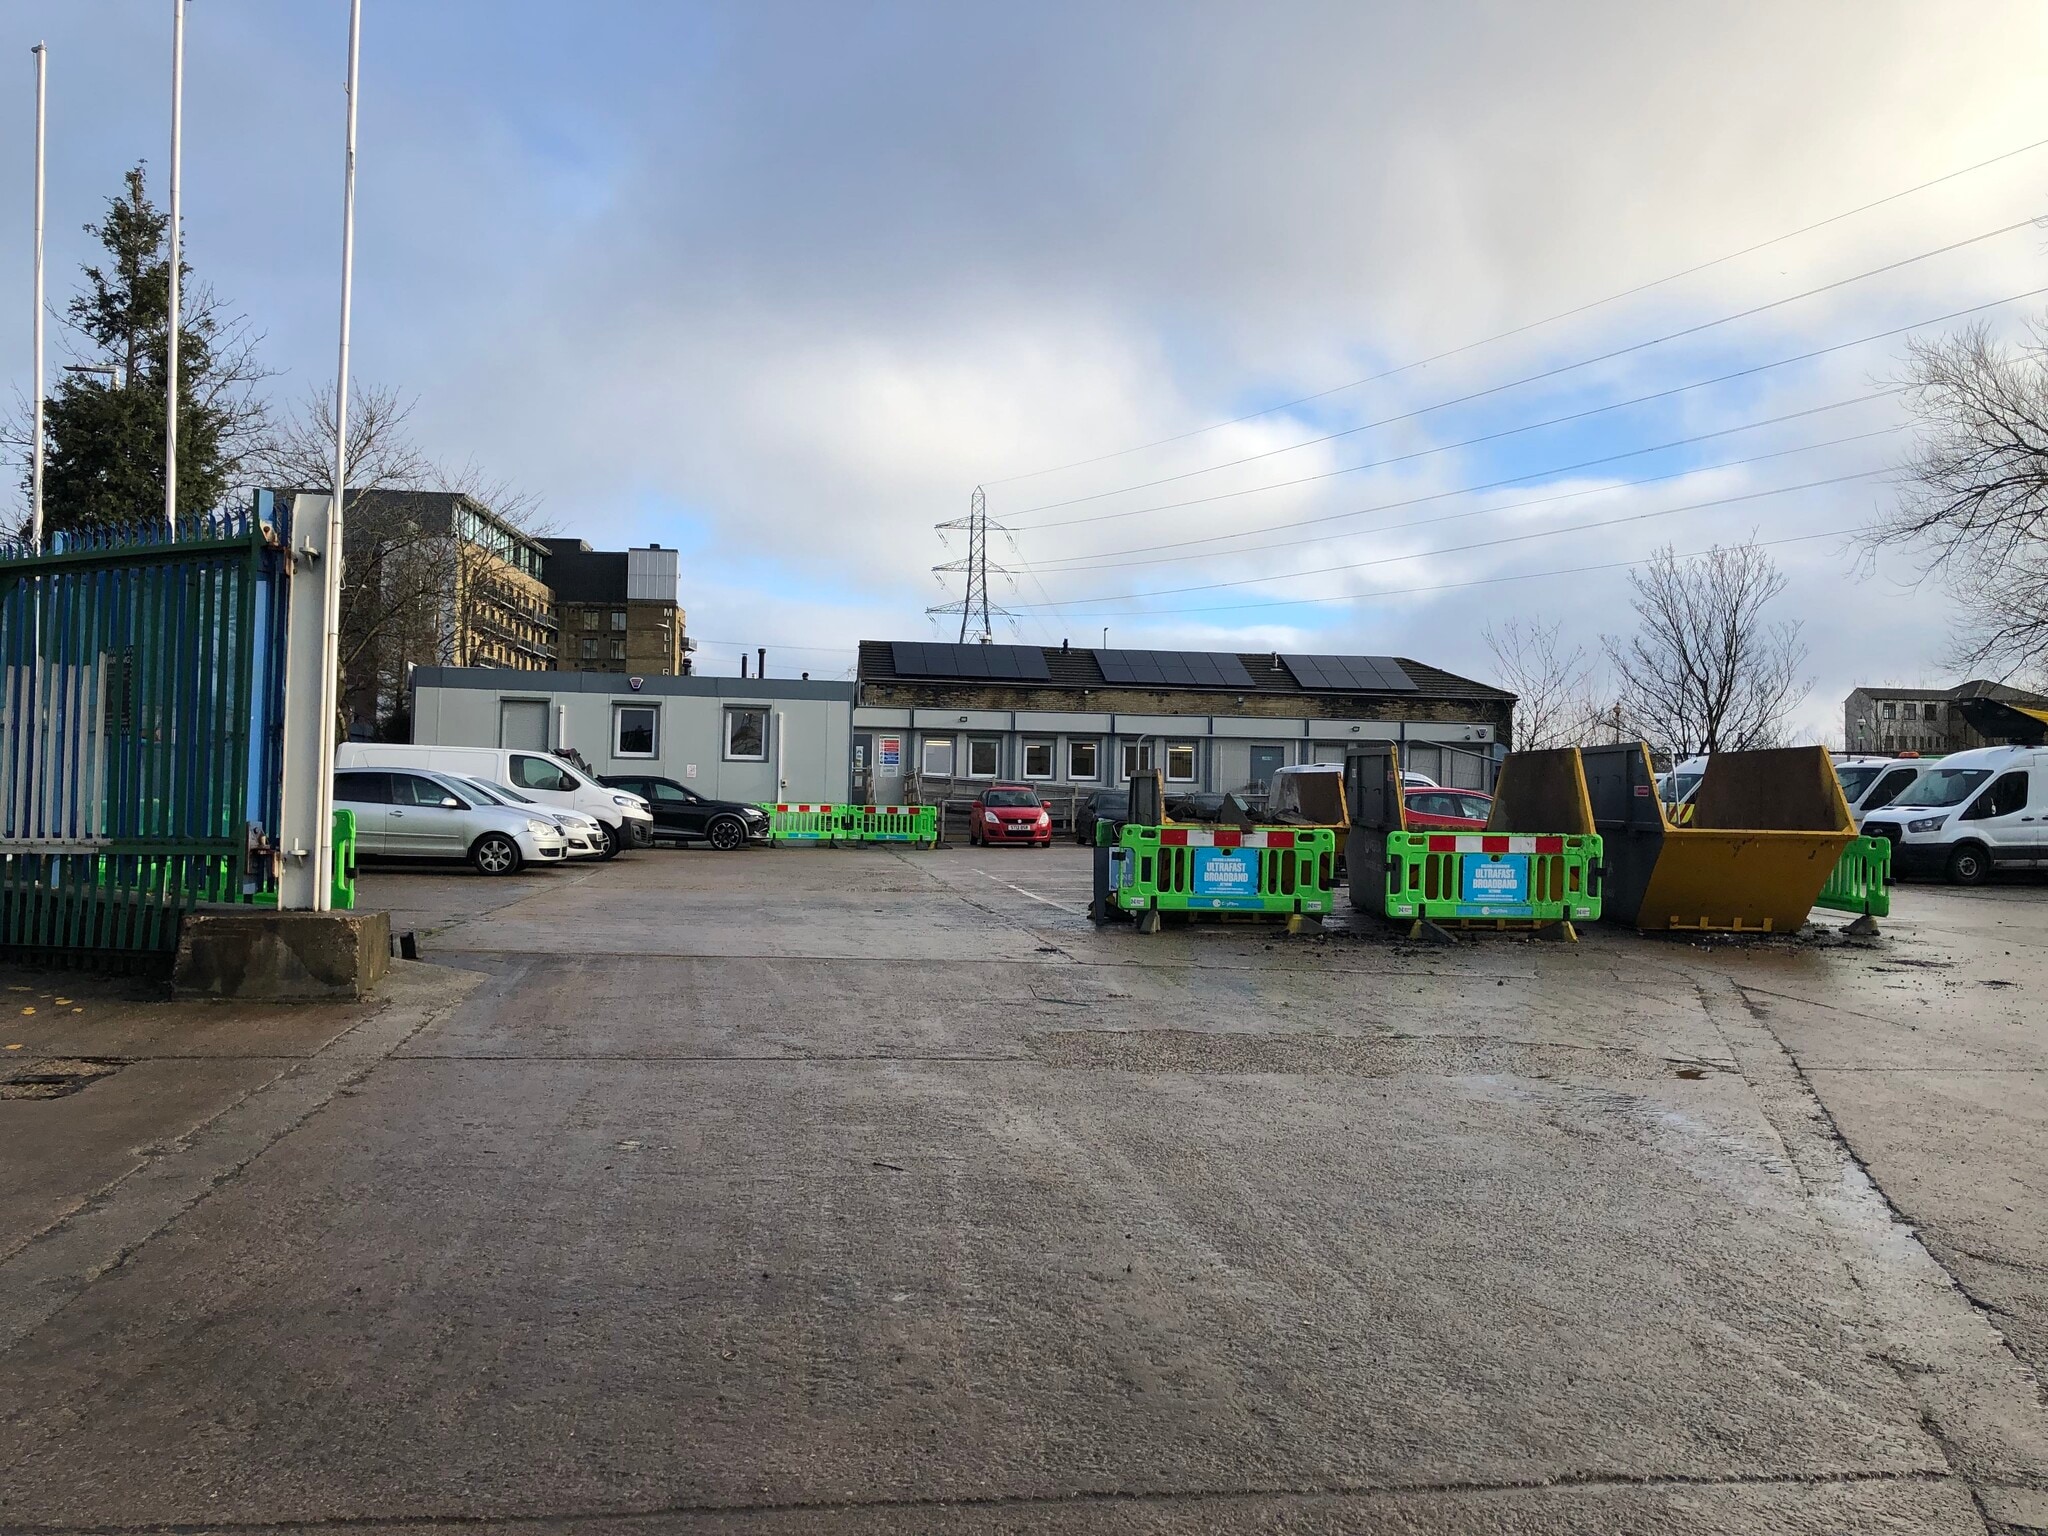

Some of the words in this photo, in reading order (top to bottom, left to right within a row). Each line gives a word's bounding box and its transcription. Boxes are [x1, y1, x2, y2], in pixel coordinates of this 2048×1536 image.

[663, 608, 673, 653] MILL
[1206, 862, 1246, 872] ULTRAFAST
[1204, 872, 1248, 882] BROADBAND
[1475, 868, 1515, 878] ULTRAFAST
[1473, 879, 1517, 889] BROADBAND
